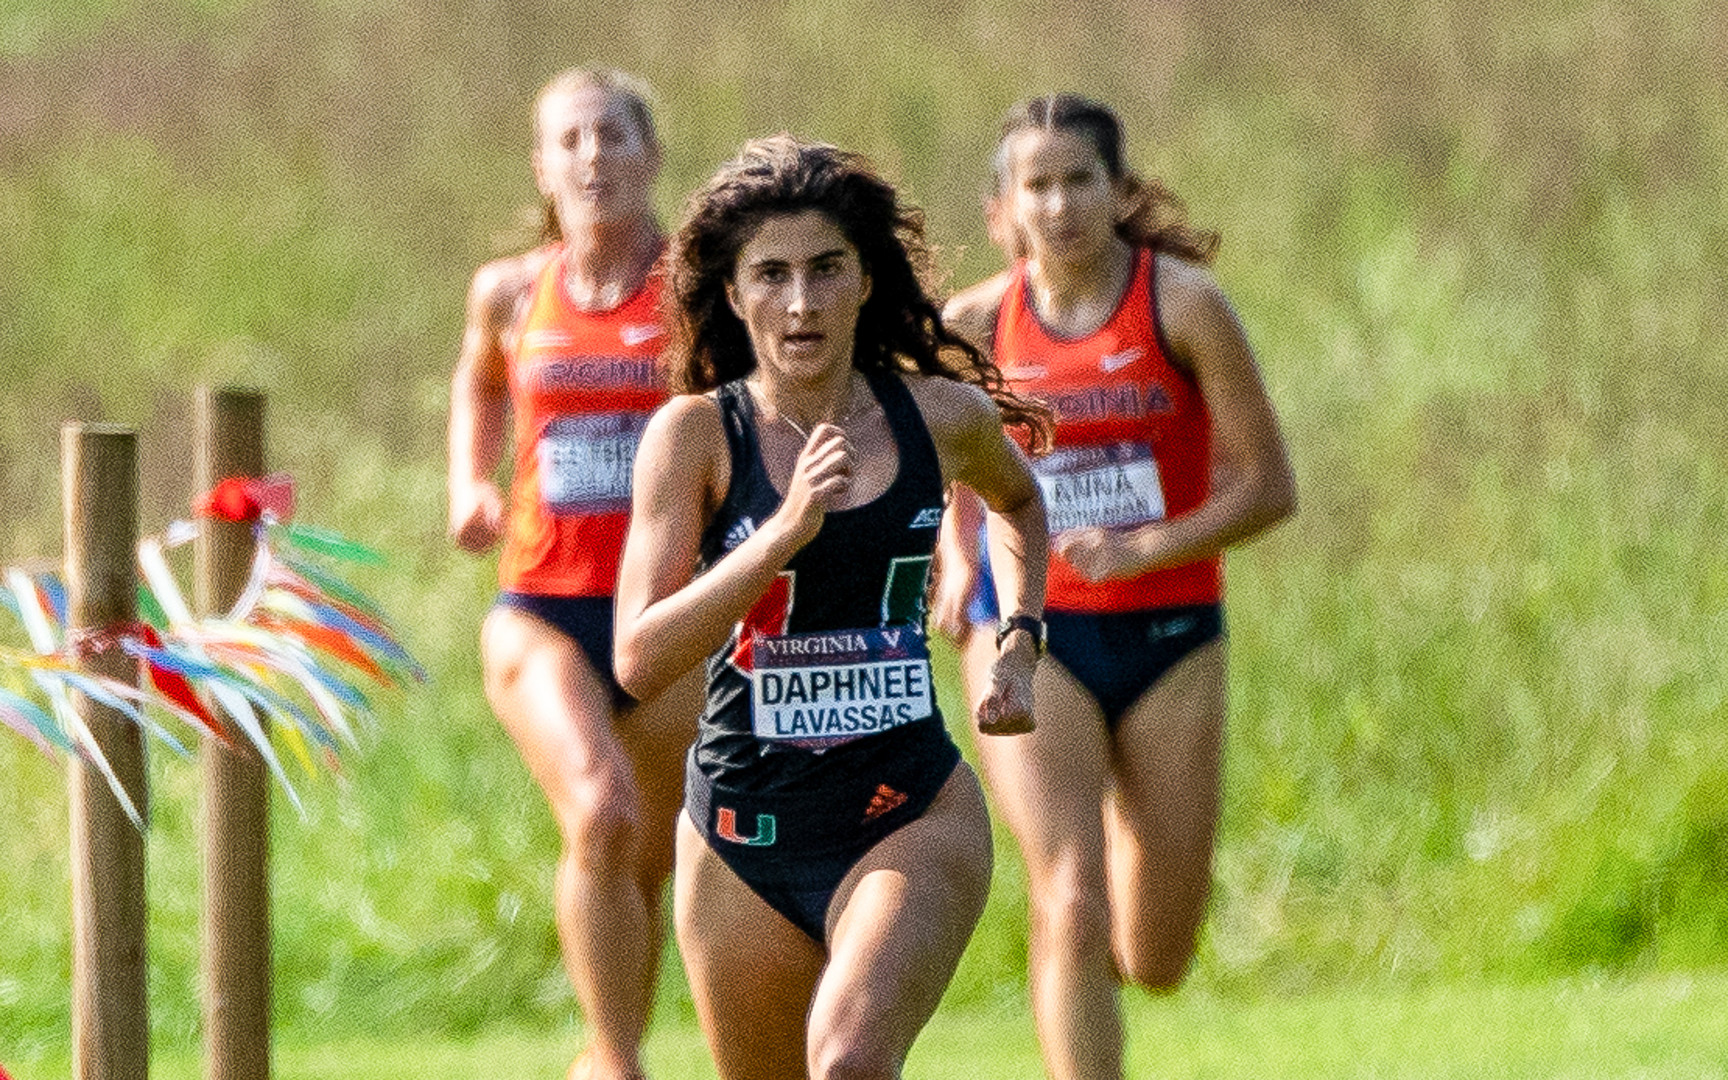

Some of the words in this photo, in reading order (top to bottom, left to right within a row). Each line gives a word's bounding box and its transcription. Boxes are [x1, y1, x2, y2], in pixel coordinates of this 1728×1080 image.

[1055, 465, 1134, 504] ANNA
[766, 633, 868, 655] VIRGINIA
[761, 664, 924, 705] DAPHNEE
[774, 703, 912, 735] LAVASSAS
[717, 807, 777, 846] U
